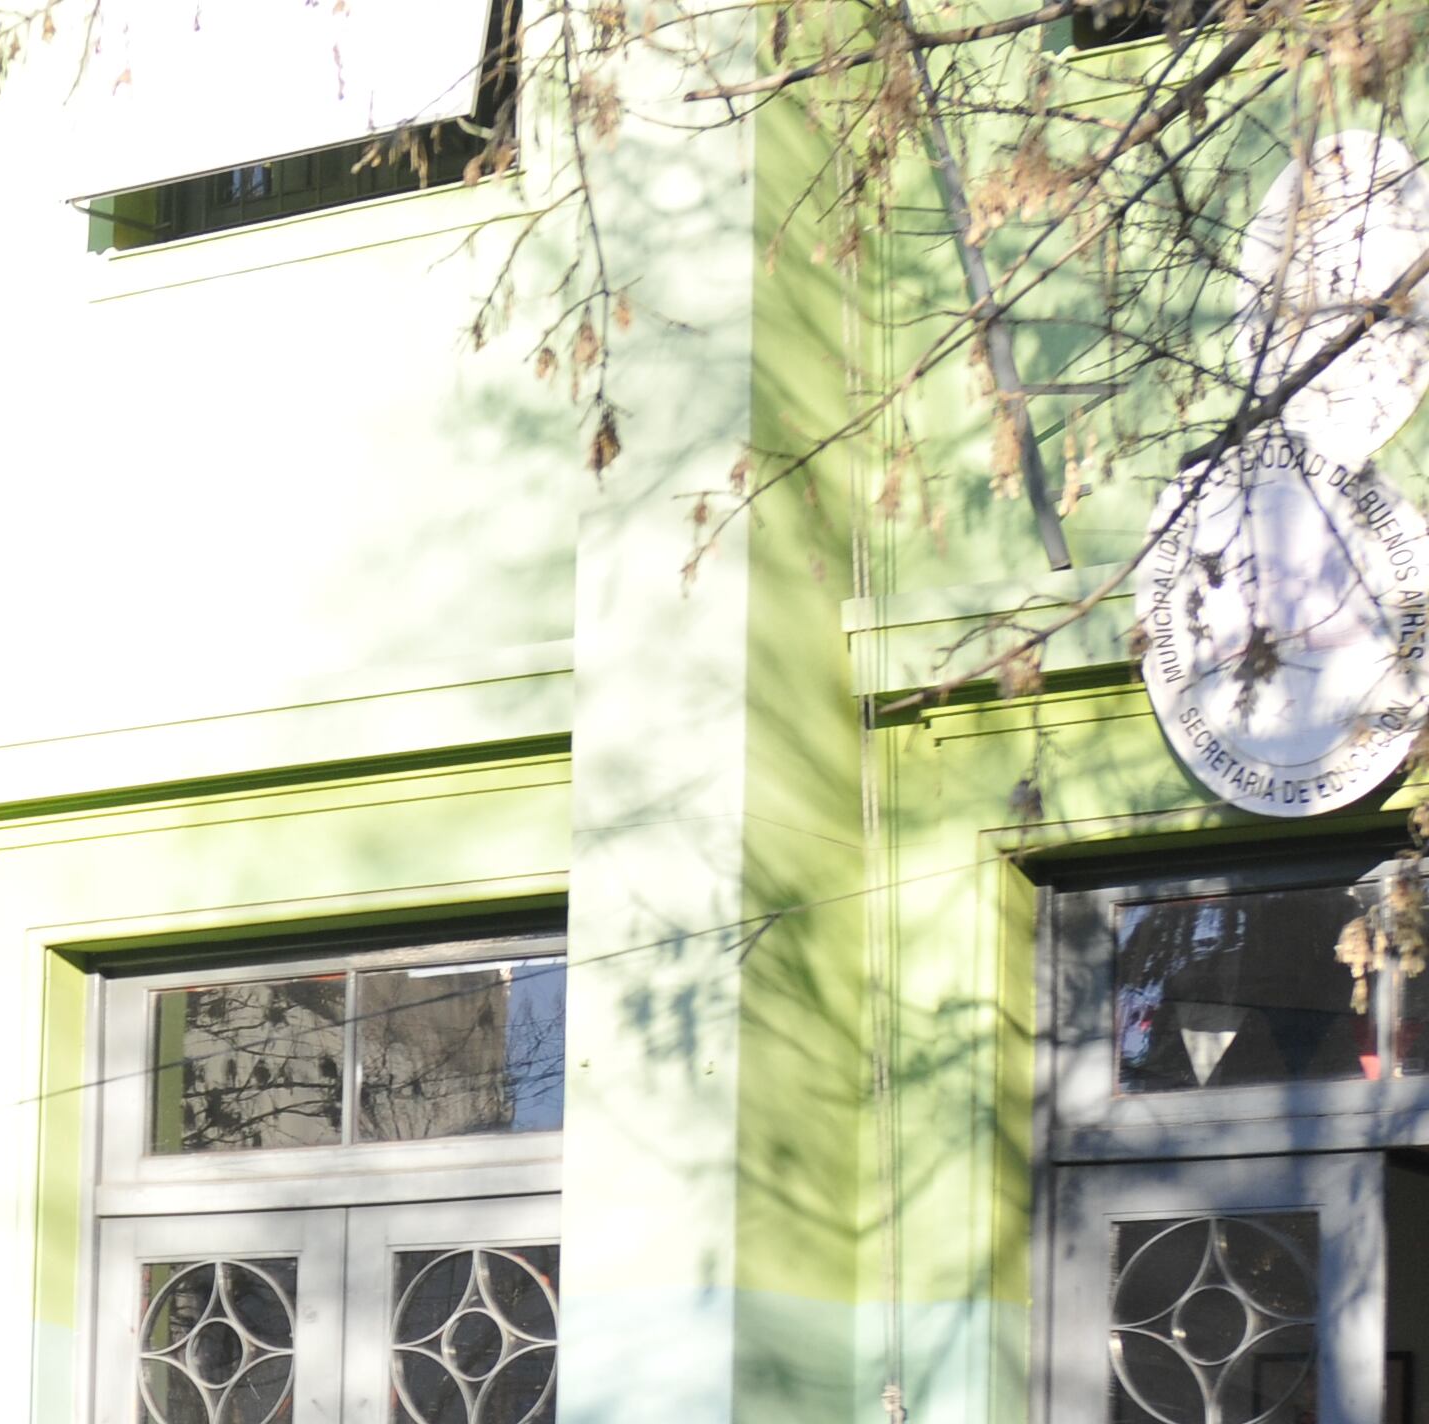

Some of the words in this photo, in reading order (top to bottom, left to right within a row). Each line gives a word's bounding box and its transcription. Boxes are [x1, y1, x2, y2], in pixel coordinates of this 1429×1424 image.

[1357, 490, 1419, 582] BUENOS
[1179, 707, 1275, 801] SECRETARIA
[1283, 780, 1310, 804] DE
